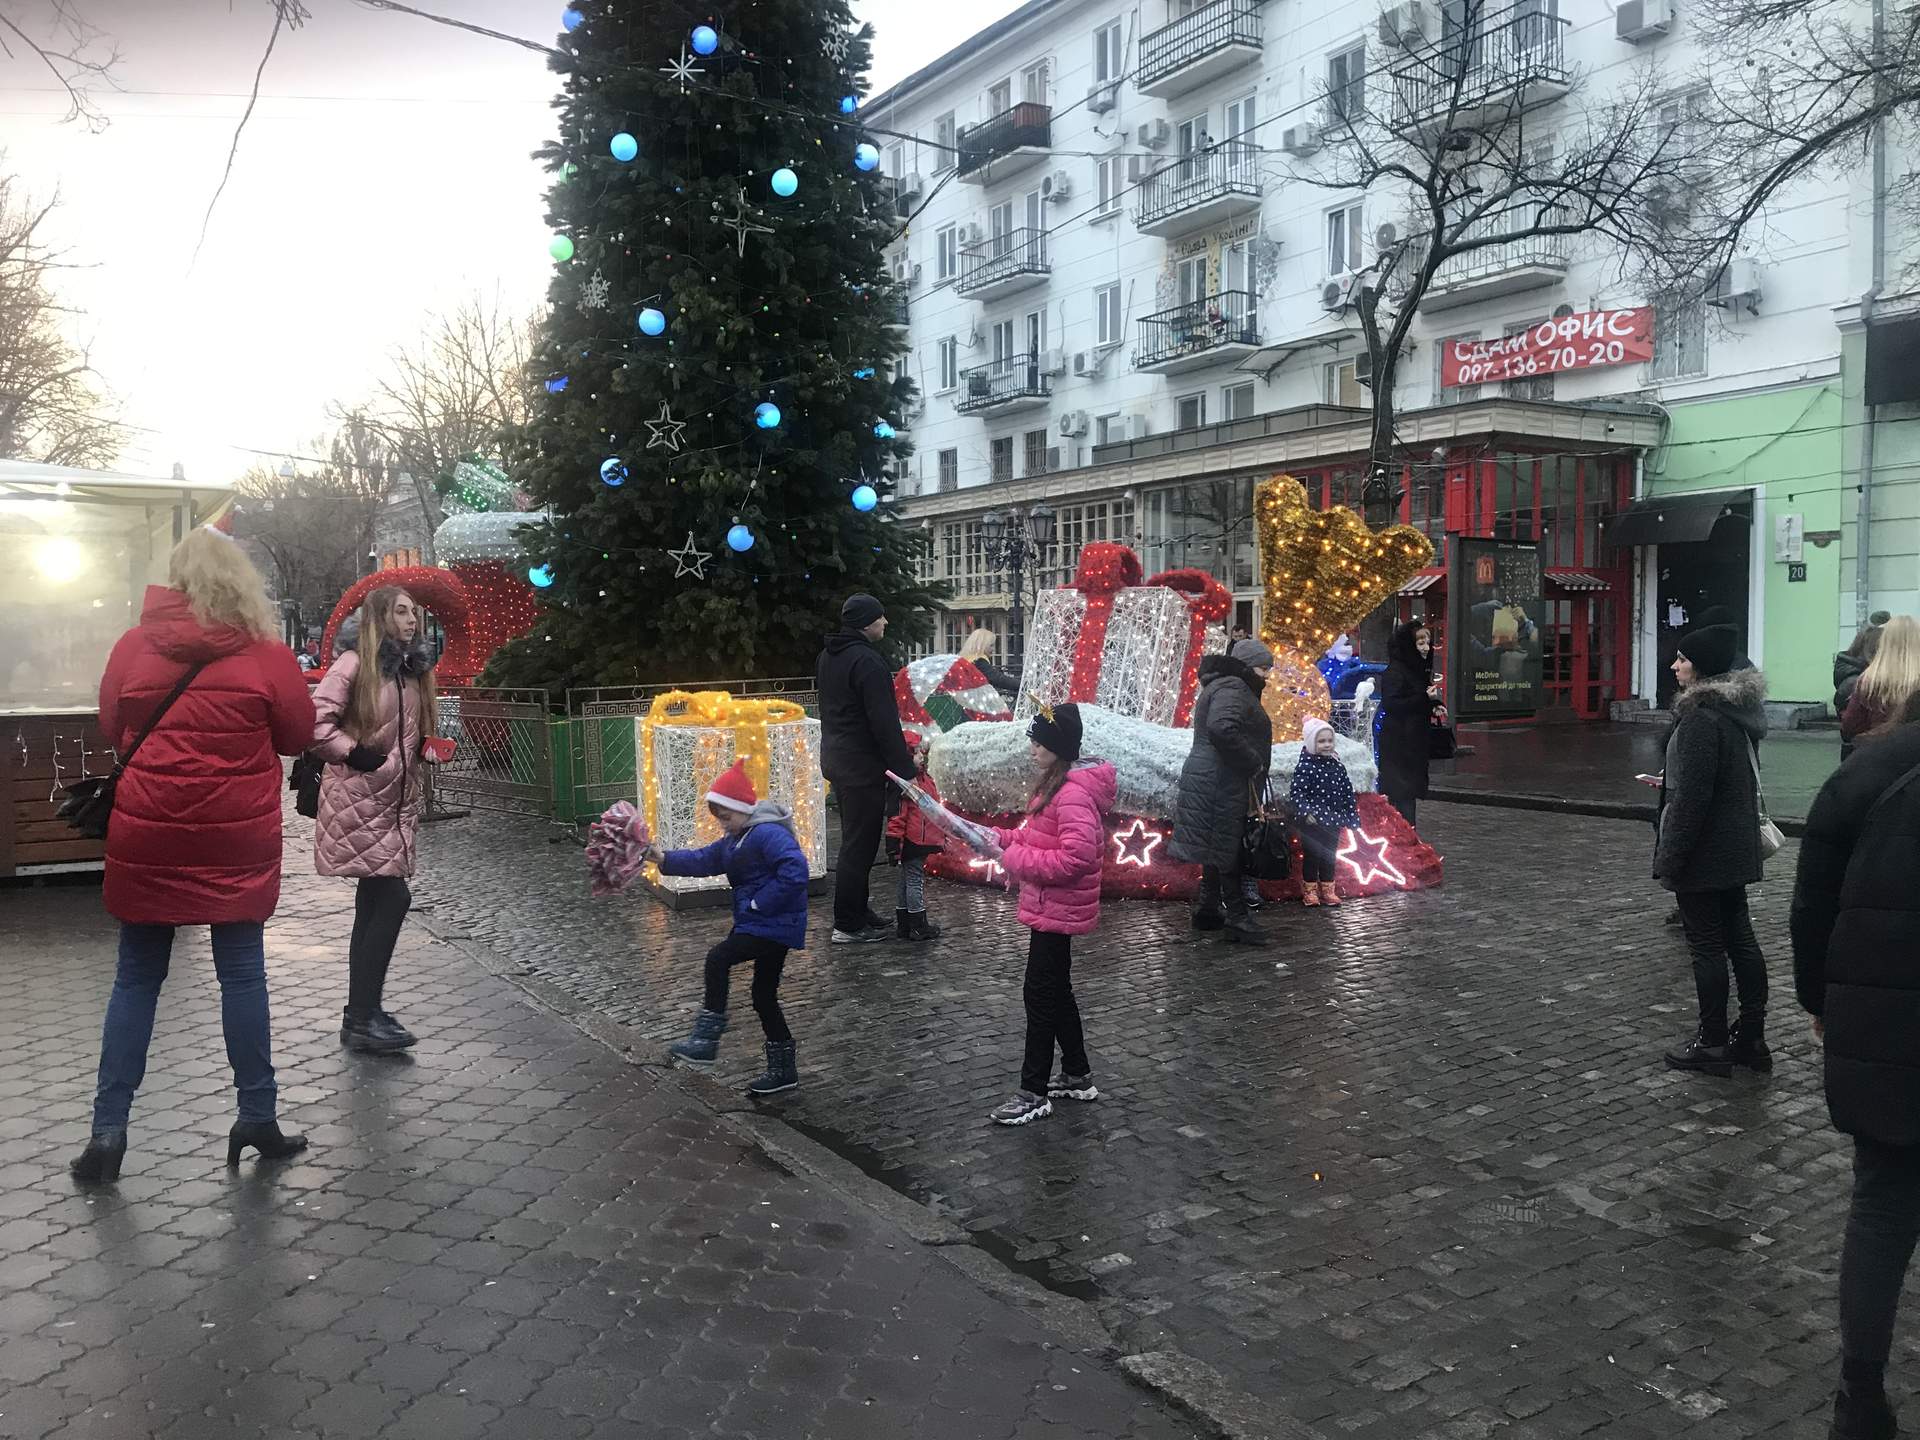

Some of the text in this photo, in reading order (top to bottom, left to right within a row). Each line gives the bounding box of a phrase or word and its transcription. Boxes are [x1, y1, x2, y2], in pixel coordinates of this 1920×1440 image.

[1535, 310, 1635, 347] ОФИС
[1458, 340, 1624, 384] 097-136-70-20
[1791, 566, 1804, 578] 20
